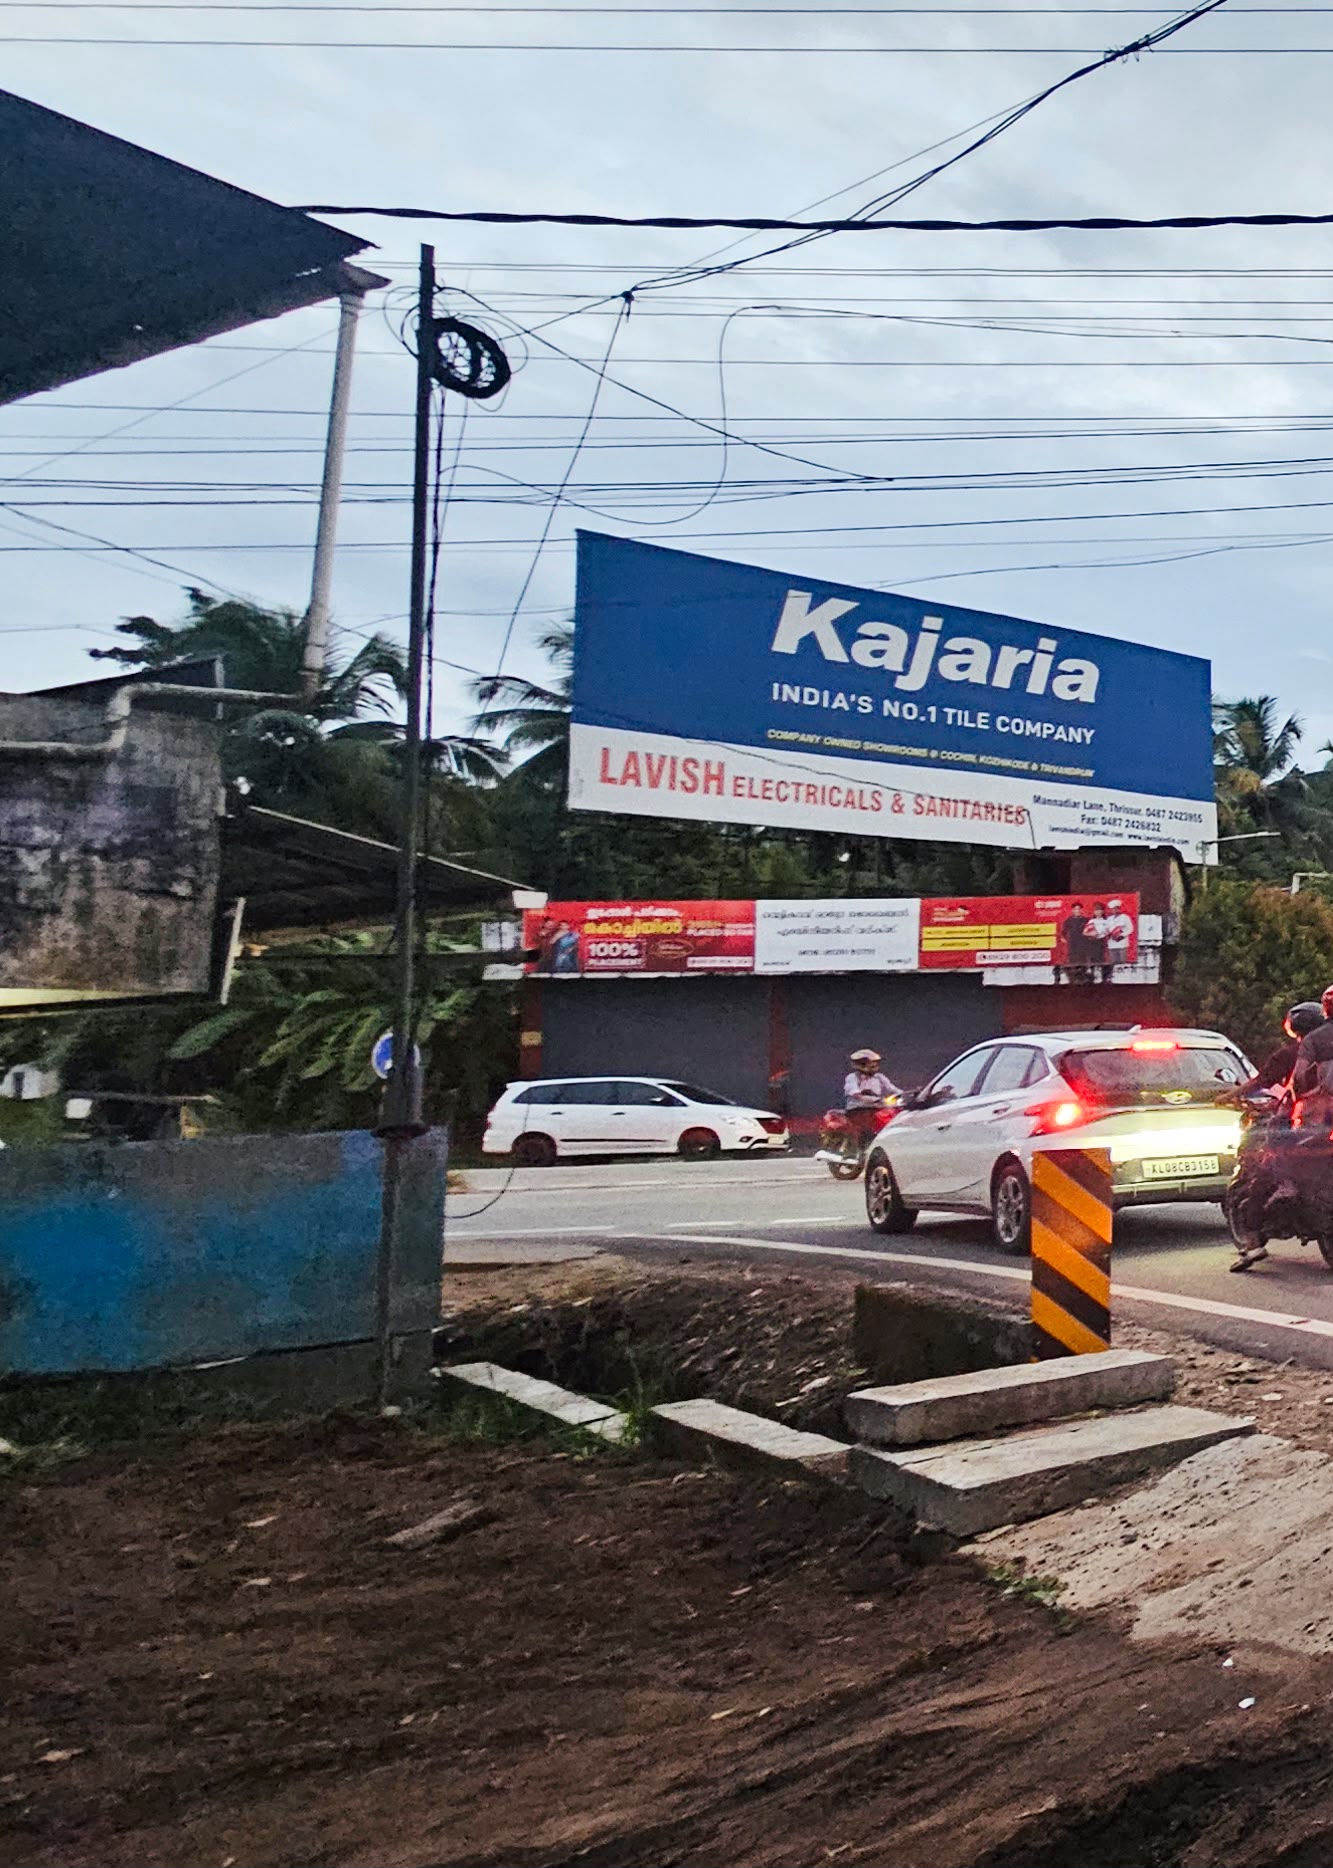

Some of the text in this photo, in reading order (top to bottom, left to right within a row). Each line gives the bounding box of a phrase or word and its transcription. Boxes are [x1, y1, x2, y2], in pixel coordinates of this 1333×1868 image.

[771, 588, 1100, 703] Kajaria
[767, 728, 823, 745] COMPANY
[823, 736, 862, 751] OWNED
[772, 682, 1096, 745] INDIA'S NO.1 TILE COMPANY
[599, 747, 1027, 826] LAVISH ELECTRICALS & SANITARIES
[588, 943, 639, 957] 100%
